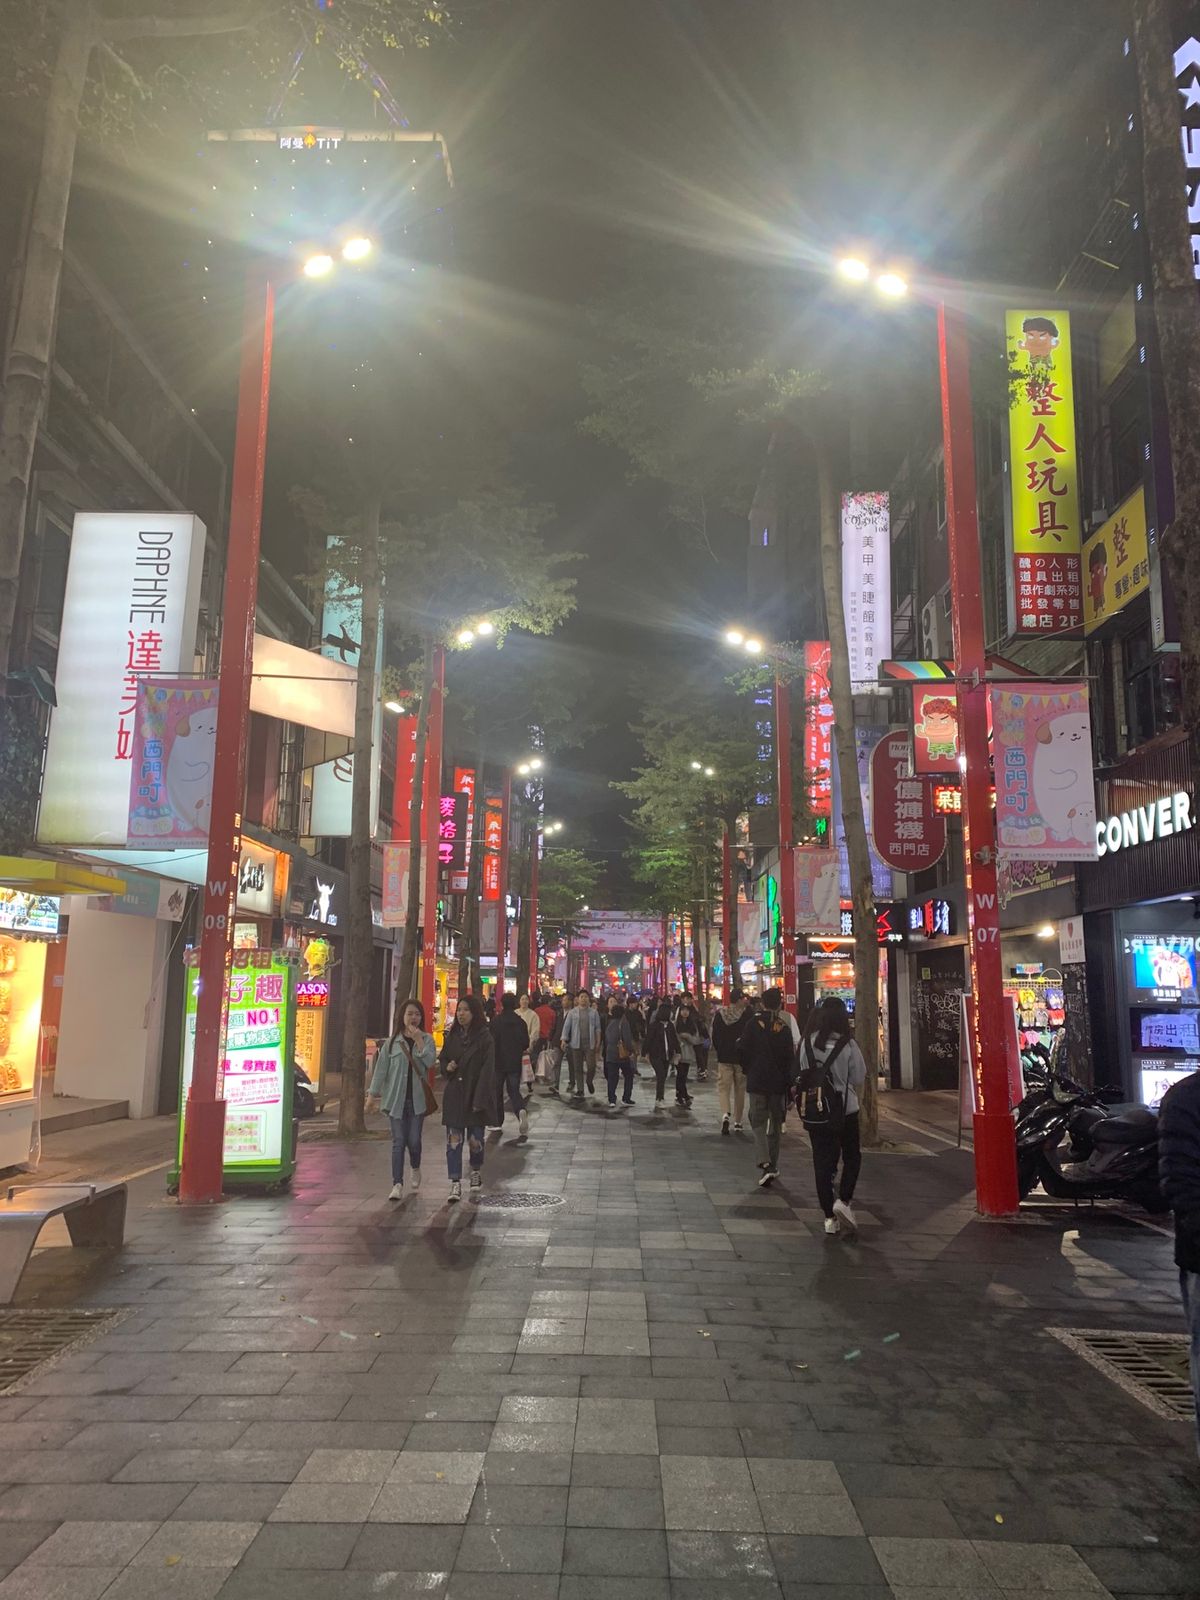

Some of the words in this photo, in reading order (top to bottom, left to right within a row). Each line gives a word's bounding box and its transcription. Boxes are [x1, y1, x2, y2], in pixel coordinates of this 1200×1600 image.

[1024, 378, 1069, 543] 整人玩具
[129, 531, 173, 624] DAPHNE
[1020, 571, 1079, 582] 道具出租
[1060, 615, 1079, 627] 2F
[1004, 747, 1029, 813] 西門町
[1095, 791, 1197, 857] CONVER
[889, 843, 930, 856] 西門店
[208, 881, 227, 897] W
[976, 894, 995, 909] W
[204, 915, 226, 930] 08
[977, 927, 998, 943] 07
[247, 1008, 280, 1025] NO.1
